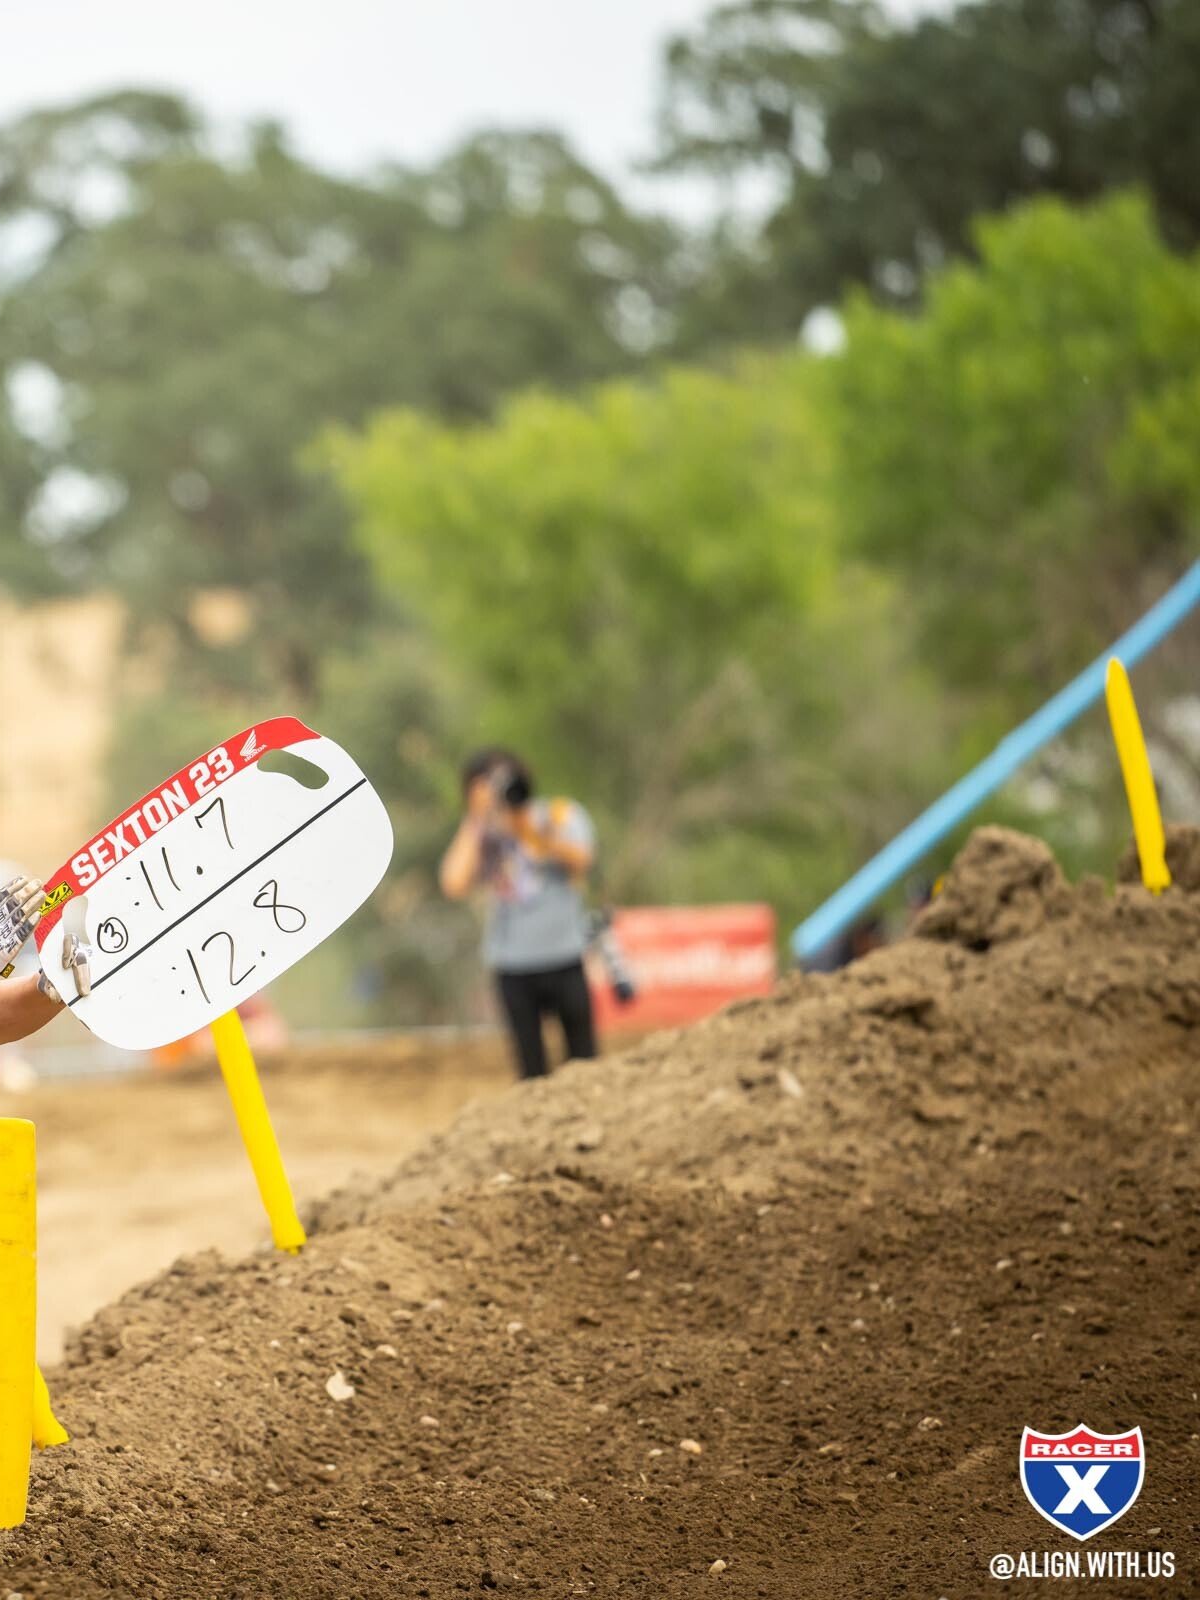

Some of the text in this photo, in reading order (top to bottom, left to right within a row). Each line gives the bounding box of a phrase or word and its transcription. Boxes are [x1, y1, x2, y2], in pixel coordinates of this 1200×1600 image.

[244, 744, 267, 762] HONDA
[71, 747, 234, 887] SEXTON 23
